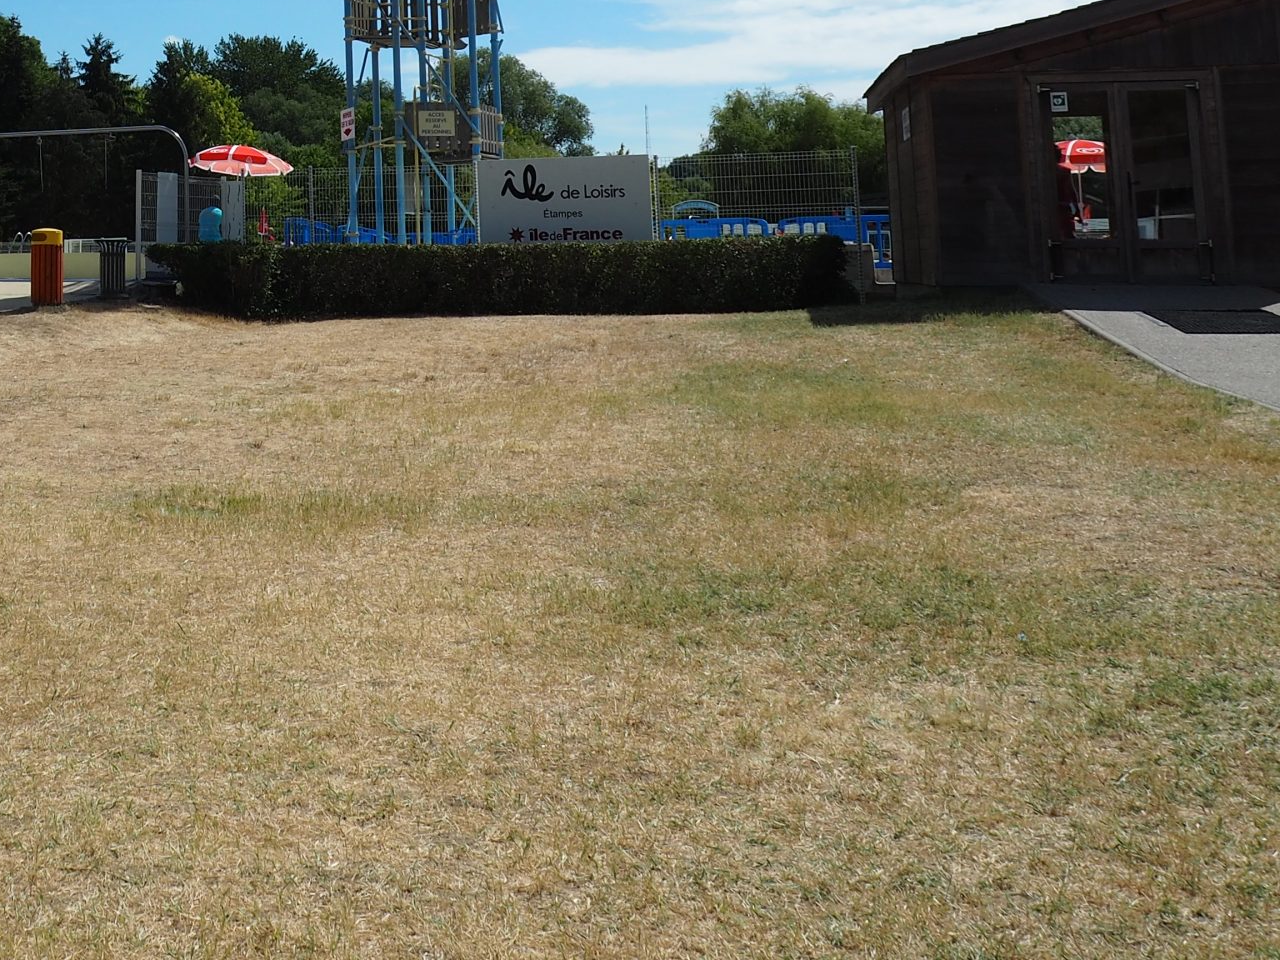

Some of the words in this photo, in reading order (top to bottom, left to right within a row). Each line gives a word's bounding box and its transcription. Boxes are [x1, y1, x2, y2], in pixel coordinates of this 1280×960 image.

[501, 164, 555, 202] île
[560, 185, 580, 199] de
[584, 184, 626, 199] Loisirs
[543, 208, 583, 219] Étampes
